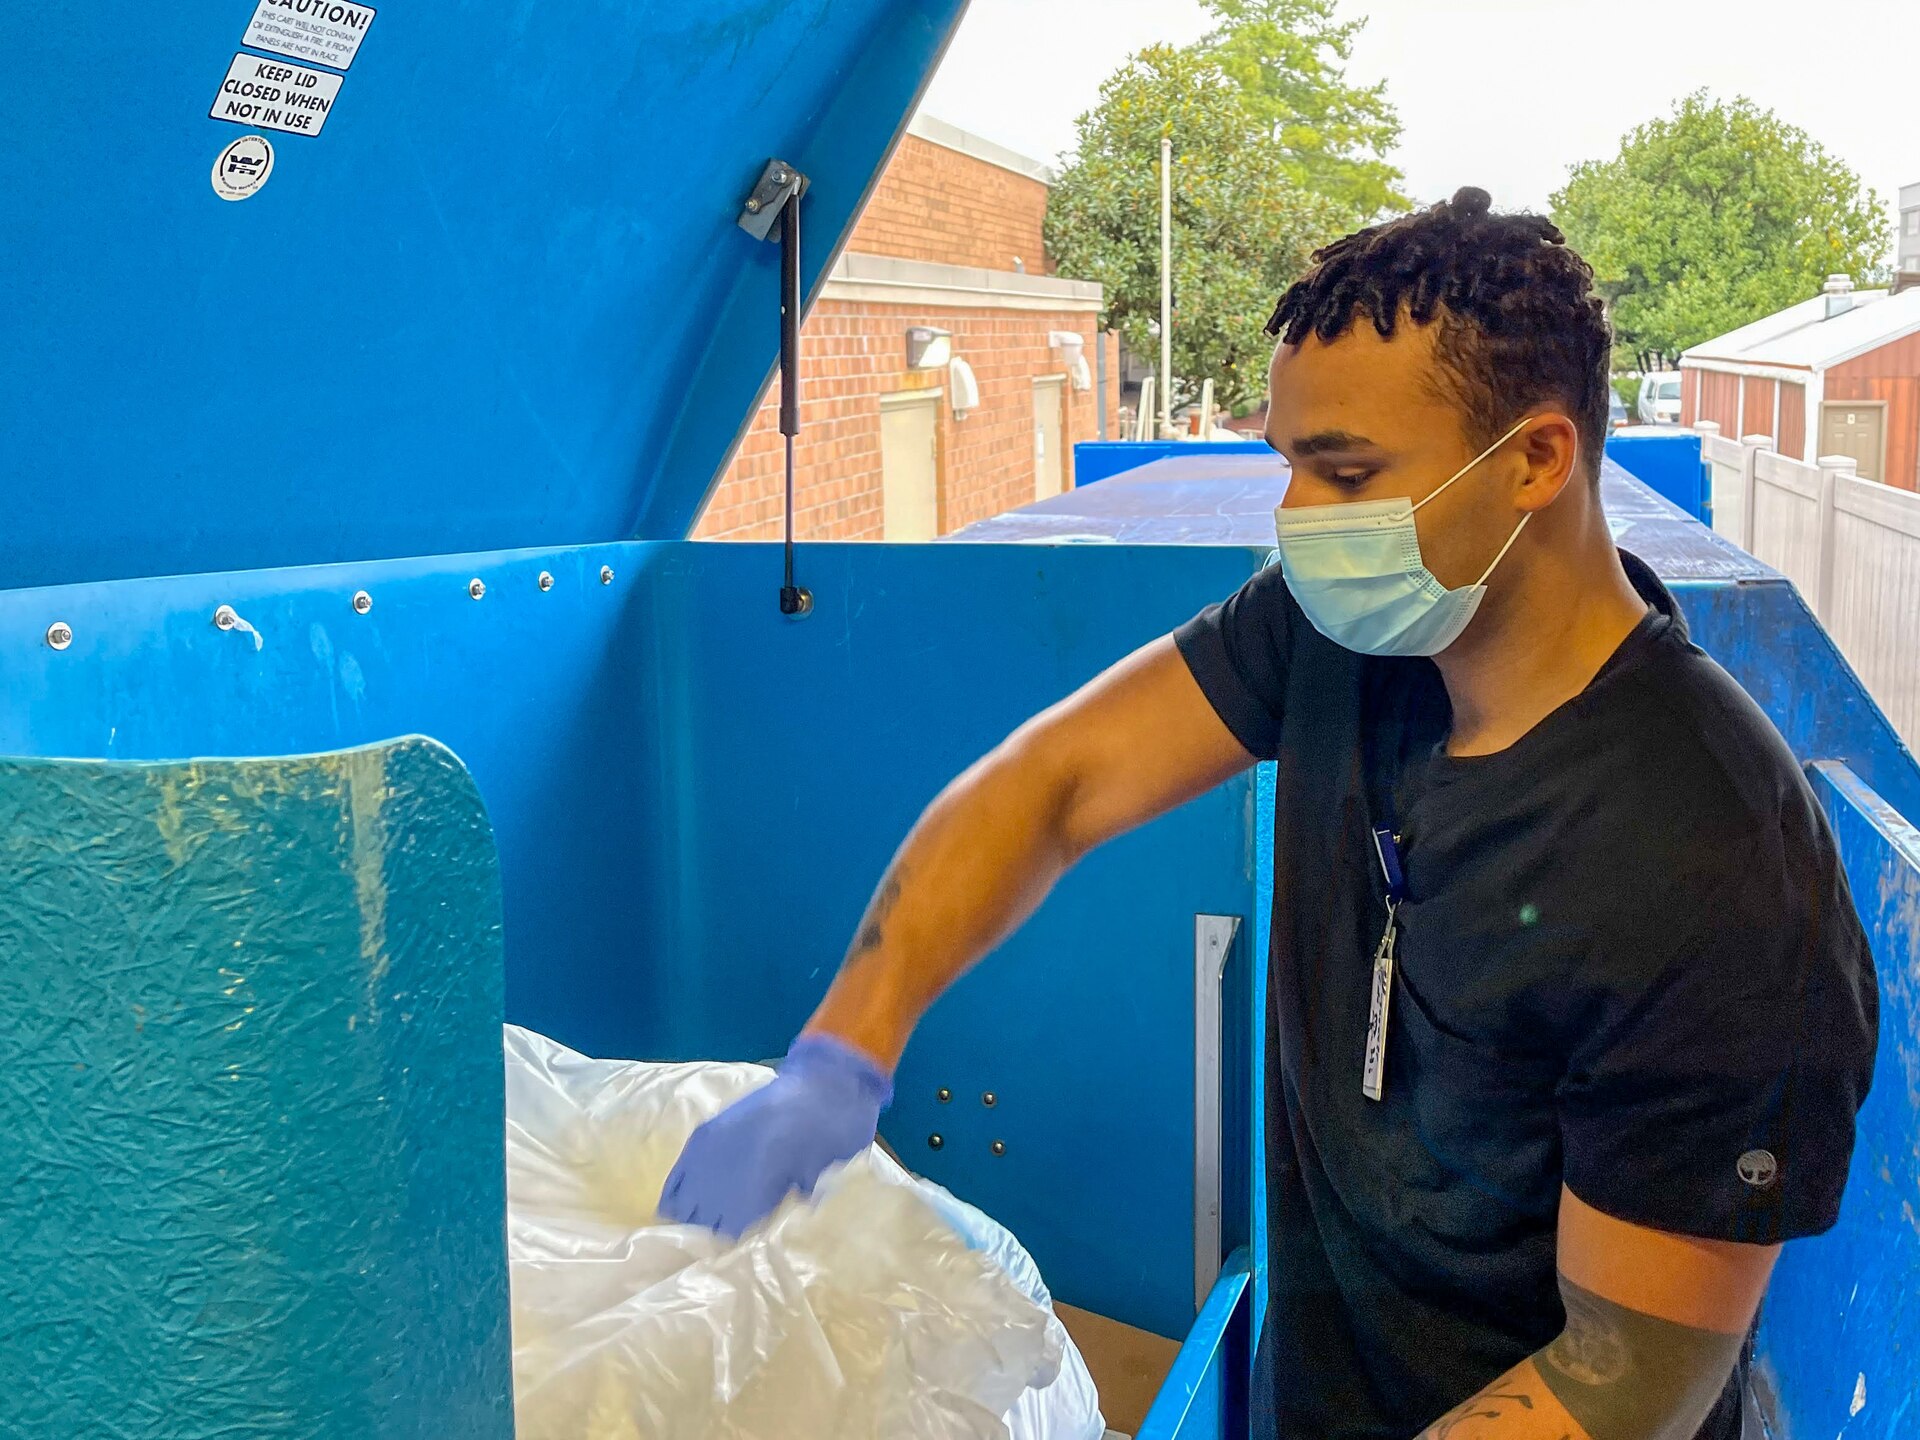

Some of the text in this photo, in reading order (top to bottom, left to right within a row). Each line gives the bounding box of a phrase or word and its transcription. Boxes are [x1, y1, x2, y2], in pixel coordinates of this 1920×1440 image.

[261, 10, 277, 21] THIS
[295, 22, 310, 31] WILL
[311, 24, 327, 34] NOT
[326, 28, 356, 42] CONTAIN
[264, 24, 304, 40] EXTINGUISH
[332, 43, 354, 54] FRONT
[256, 34, 281, 48] PANELS
[281, 42, 295, 51] ARE
[295, 45, 311, 54] NOT
[255, 63, 318, 89] KEEP LID
[224, 79, 330, 113] CLOSED WHEN
[225, 101, 313, 130] NOT IN USE
